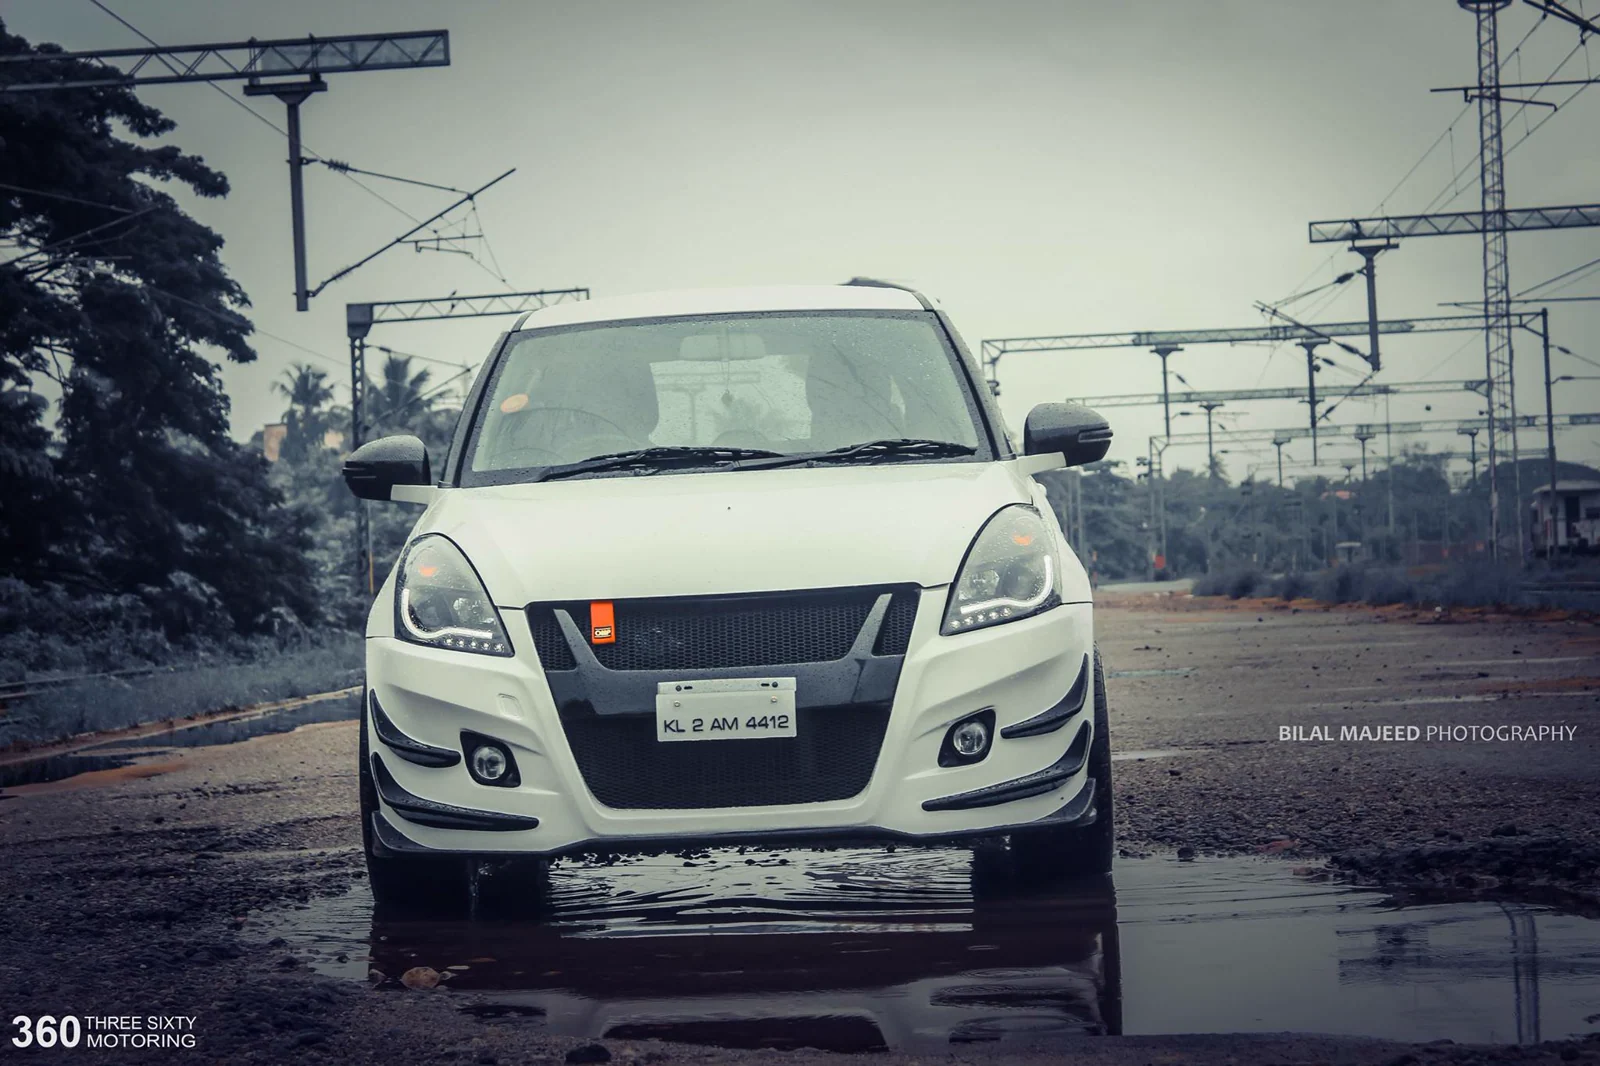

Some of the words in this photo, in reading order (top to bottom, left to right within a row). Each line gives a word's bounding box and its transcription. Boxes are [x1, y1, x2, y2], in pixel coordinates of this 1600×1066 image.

[663, 719, 686, 733] KL
[692, 718, 704, 732] 2
[710, 717, 739, 731] AM
[745, 714, 789, 730] 4412
